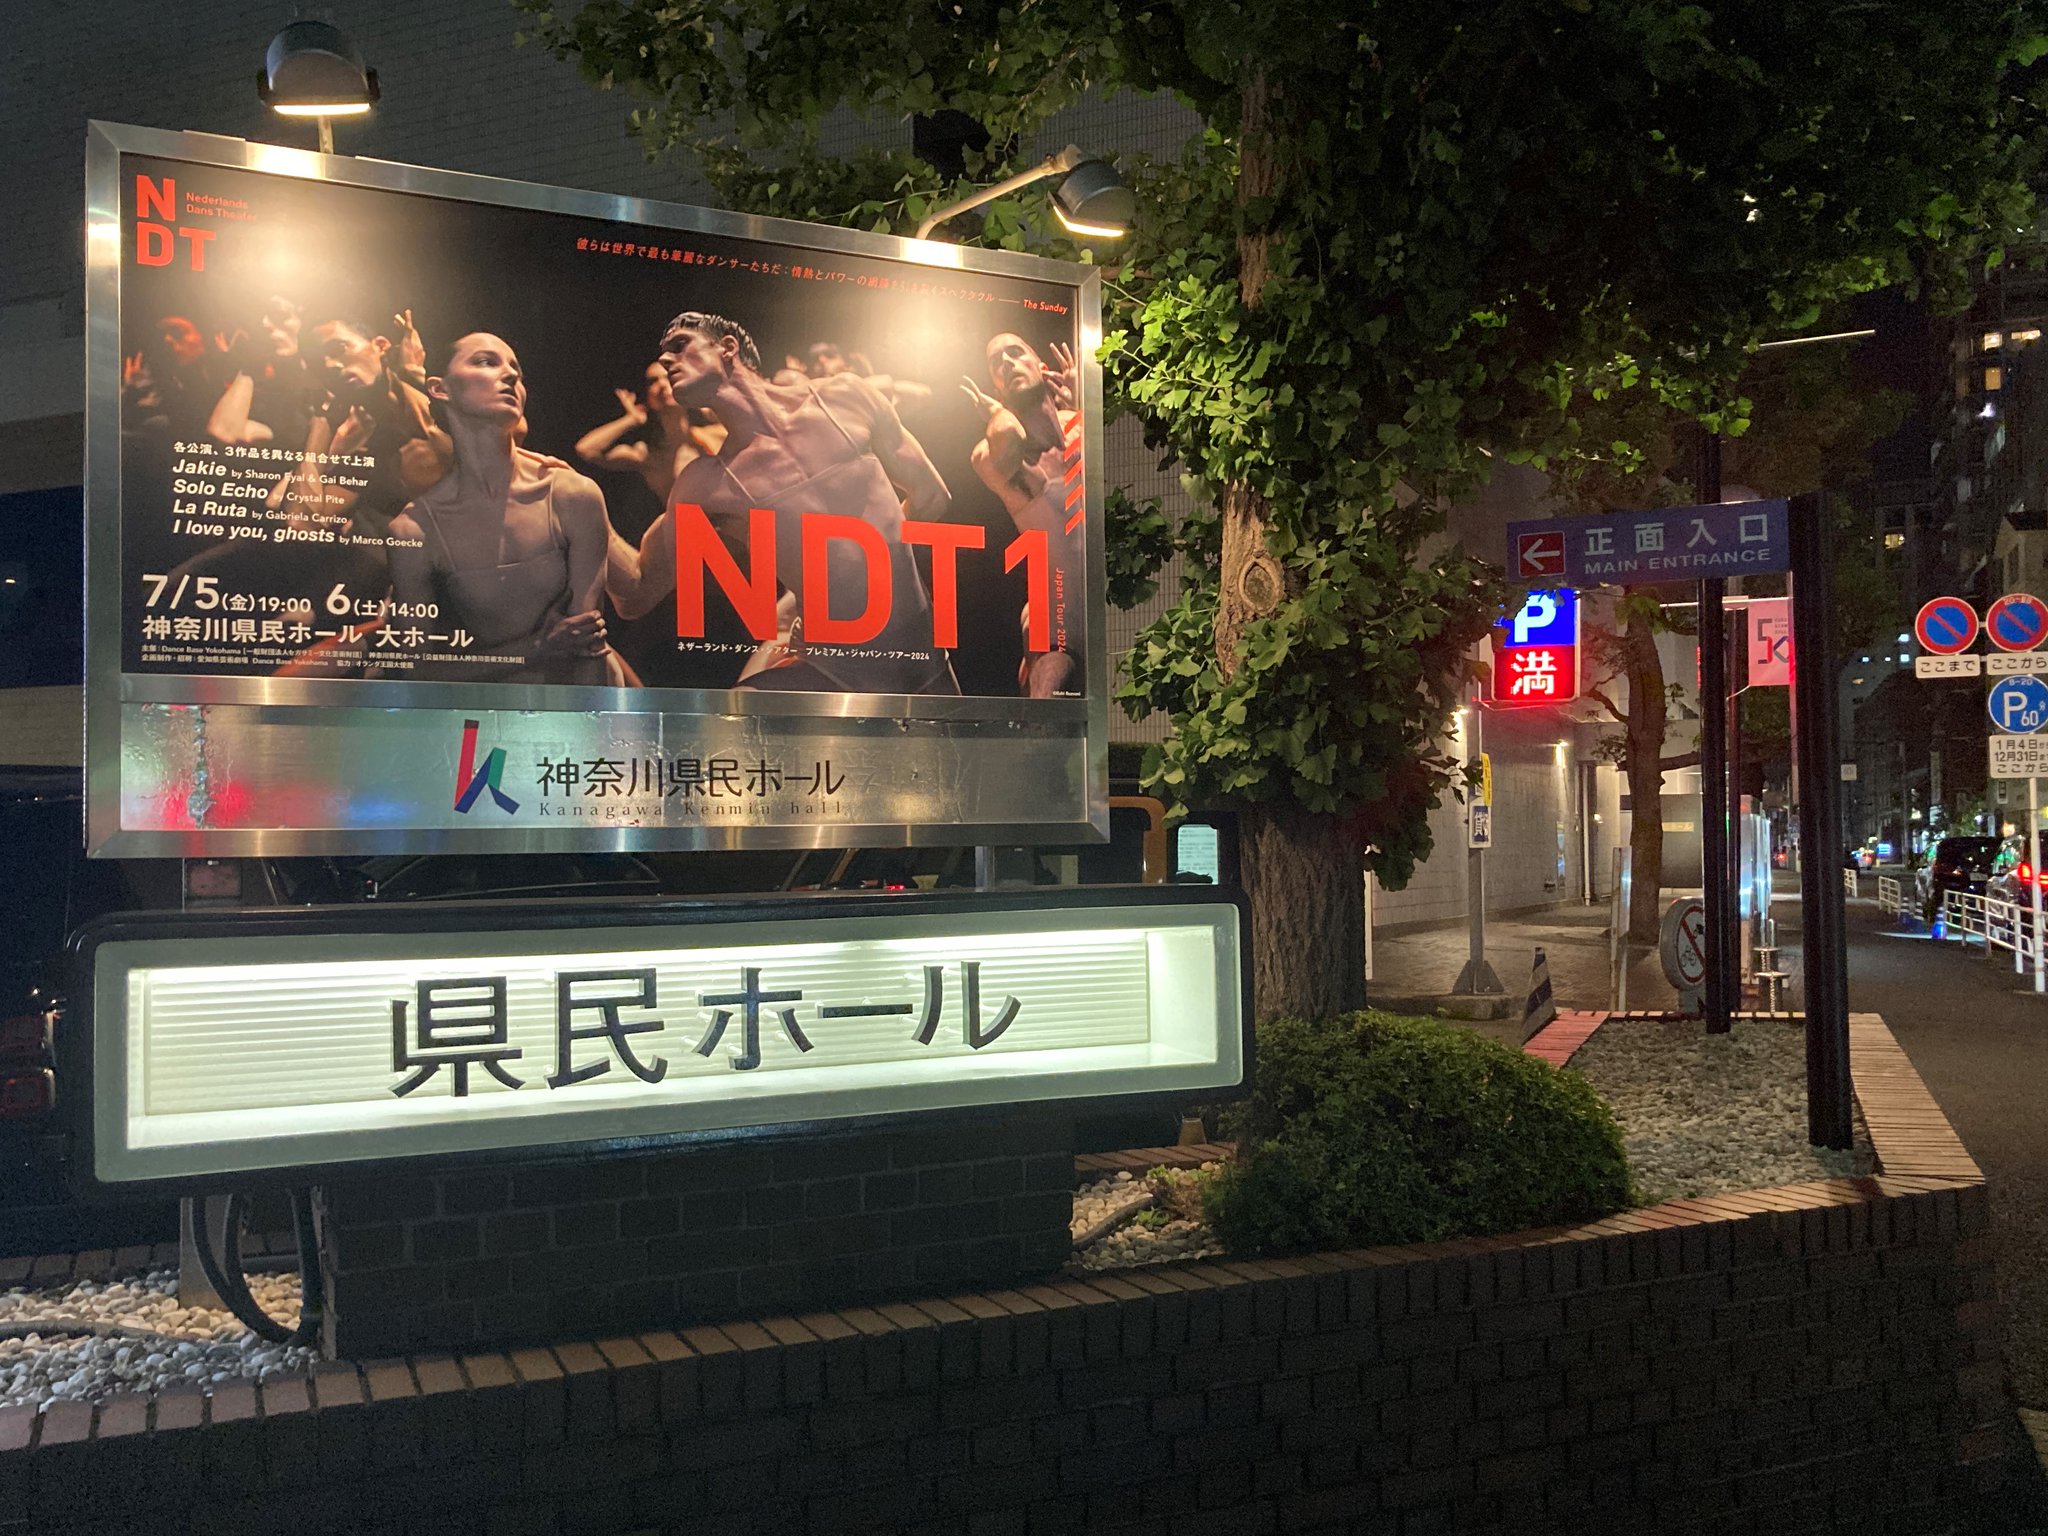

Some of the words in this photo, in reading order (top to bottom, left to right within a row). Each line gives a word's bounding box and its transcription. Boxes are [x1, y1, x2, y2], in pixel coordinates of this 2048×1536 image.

[186, 192, 249, 209] Nederlands
[186, 204, 214, 216] Dans
[1023, 299, 1038, 309] The
[1039, 301, 1068, 314] Sunday
[172, 459, 227, 476] Jakie
[231, 469, 243, 479] by
[245, 470, 281, 481] Sharon
[284, 472, 305, 484] Eyal
[339, 476, 368, 487] Behar
[173, 479, 216, 496] Solo
[221, 482, 268, 499] Echo
[286, 492, 322, 503] Crystal
[325, 494, 345, 505] Pite
[173, 500, 197, 514] La
[202, 501, 247, 517] Ruta
[251, 510, 263, 520] by
[266, 511, 309, 522] Gabriela
[312, 513, 348, 524] Carrizo
[173, 519, 180, 533] I
[185, 520, 224, 536] love
[229, 525, 268, 541] you,
[274, 526, 335, 543] ghosts
[339, 535, 350, 545] by
[352, 535, 384, 546] Marco
[386, 537, 423, 548] Goecke
[1584, 513, 1769, 557] 正面入口
[1585, 559, 1638, 575] MAIN
[1648, 549, 1771, 569] ENTRANCE
[1055, 567, 1065, 599] Japan
[1056, 602, 1066, 625] Tour
[1514, 594, 1557, 642] P
[142, 615, 363, 645] 神奈川県民ホール
[375, 624, 474, 648] 大ホール
[1057, 629, 1067, 653] 2024
[1510, 651, 1557, 695] 満
[1920, 660, 1976, 673] ここまで
[1992, 657, 2047, 670] ここから
[2003, 691, 2028, 727] P
[535, 757, 845, 798] 神奈川県民ホール
[539, 802, 662, 819] Kanagawa
[685, 801, 772, 815] Kenmin
[791, 801, 841, 814] hall
[388, 960, 1021, 1098] 県民ホール
